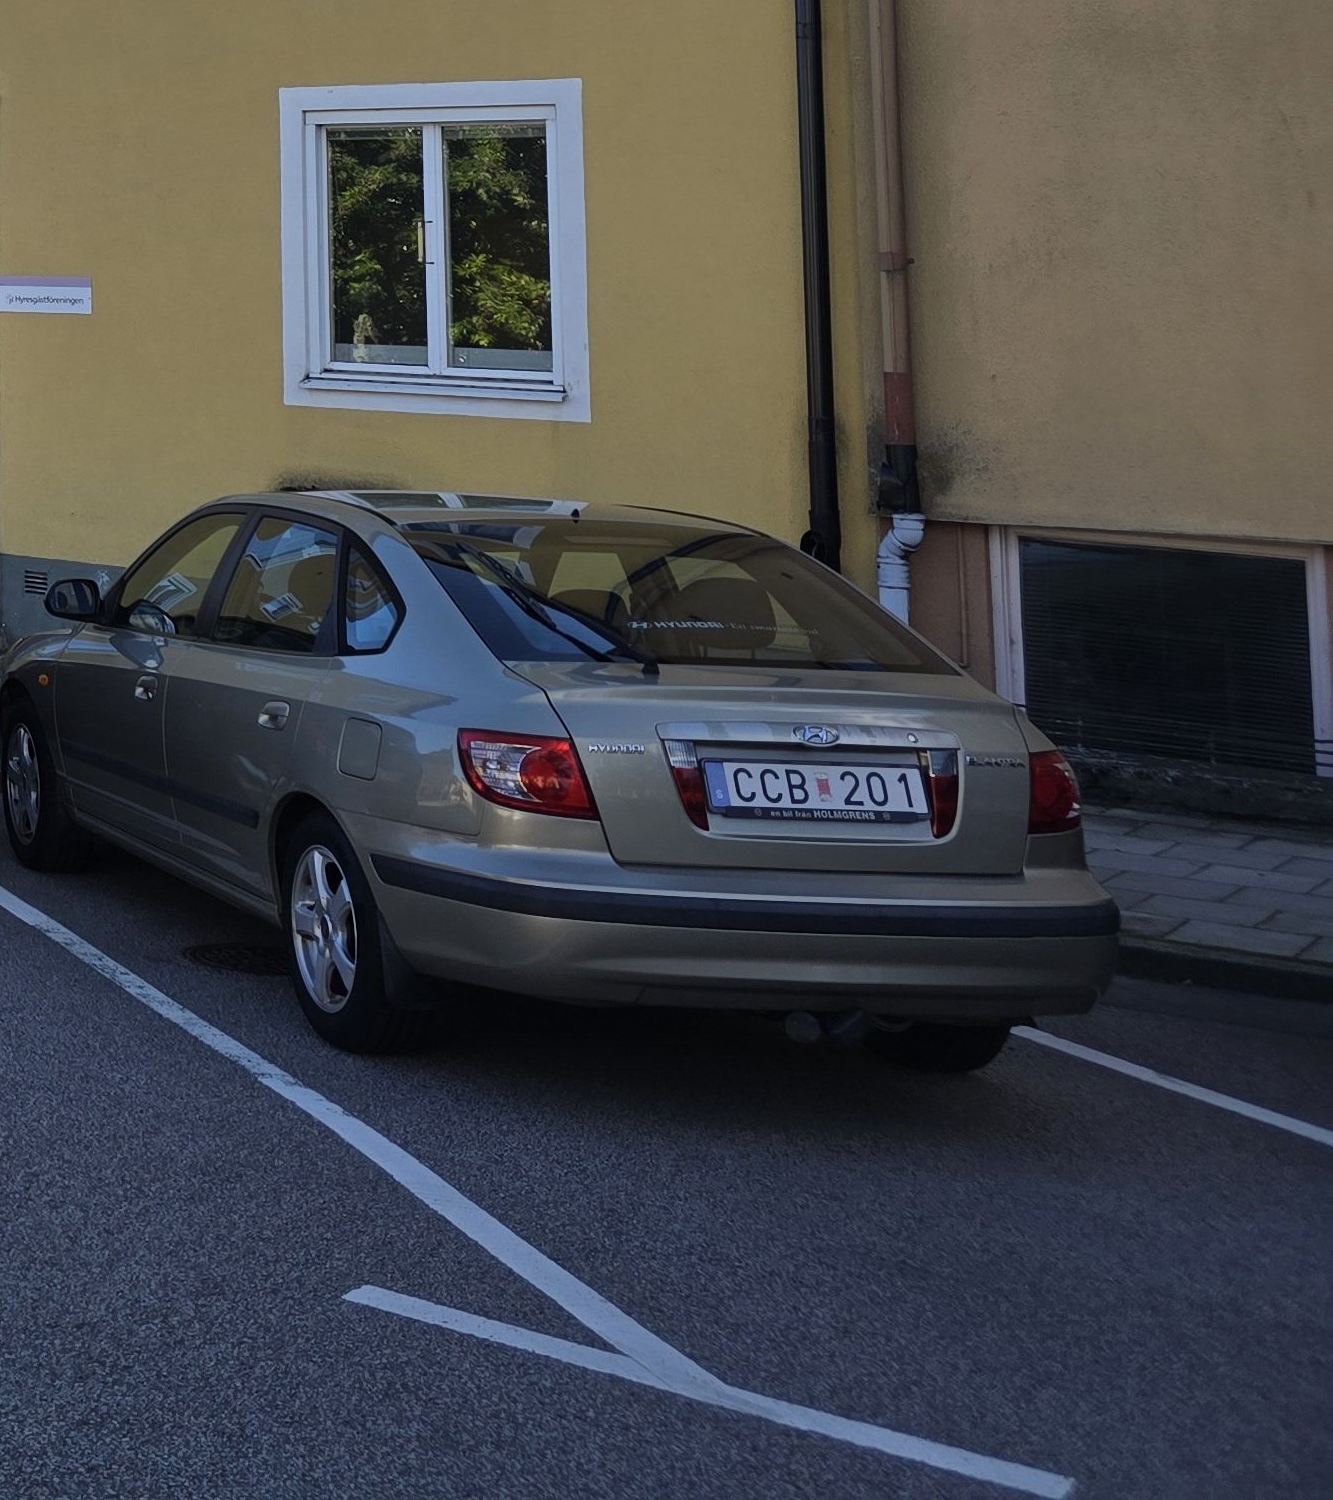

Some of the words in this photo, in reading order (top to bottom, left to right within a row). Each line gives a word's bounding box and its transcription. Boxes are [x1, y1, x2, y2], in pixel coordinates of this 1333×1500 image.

[653, 621, 725, 629] HYUNDAI
[588, 743, 645, 753] HYUNDAI
[732, 767, 809, 804] CCB
[839, 771, 914, 808] 201
[782, 809, 793, 818] bil
[813, 809, 876, 820] HOLMGRENS
